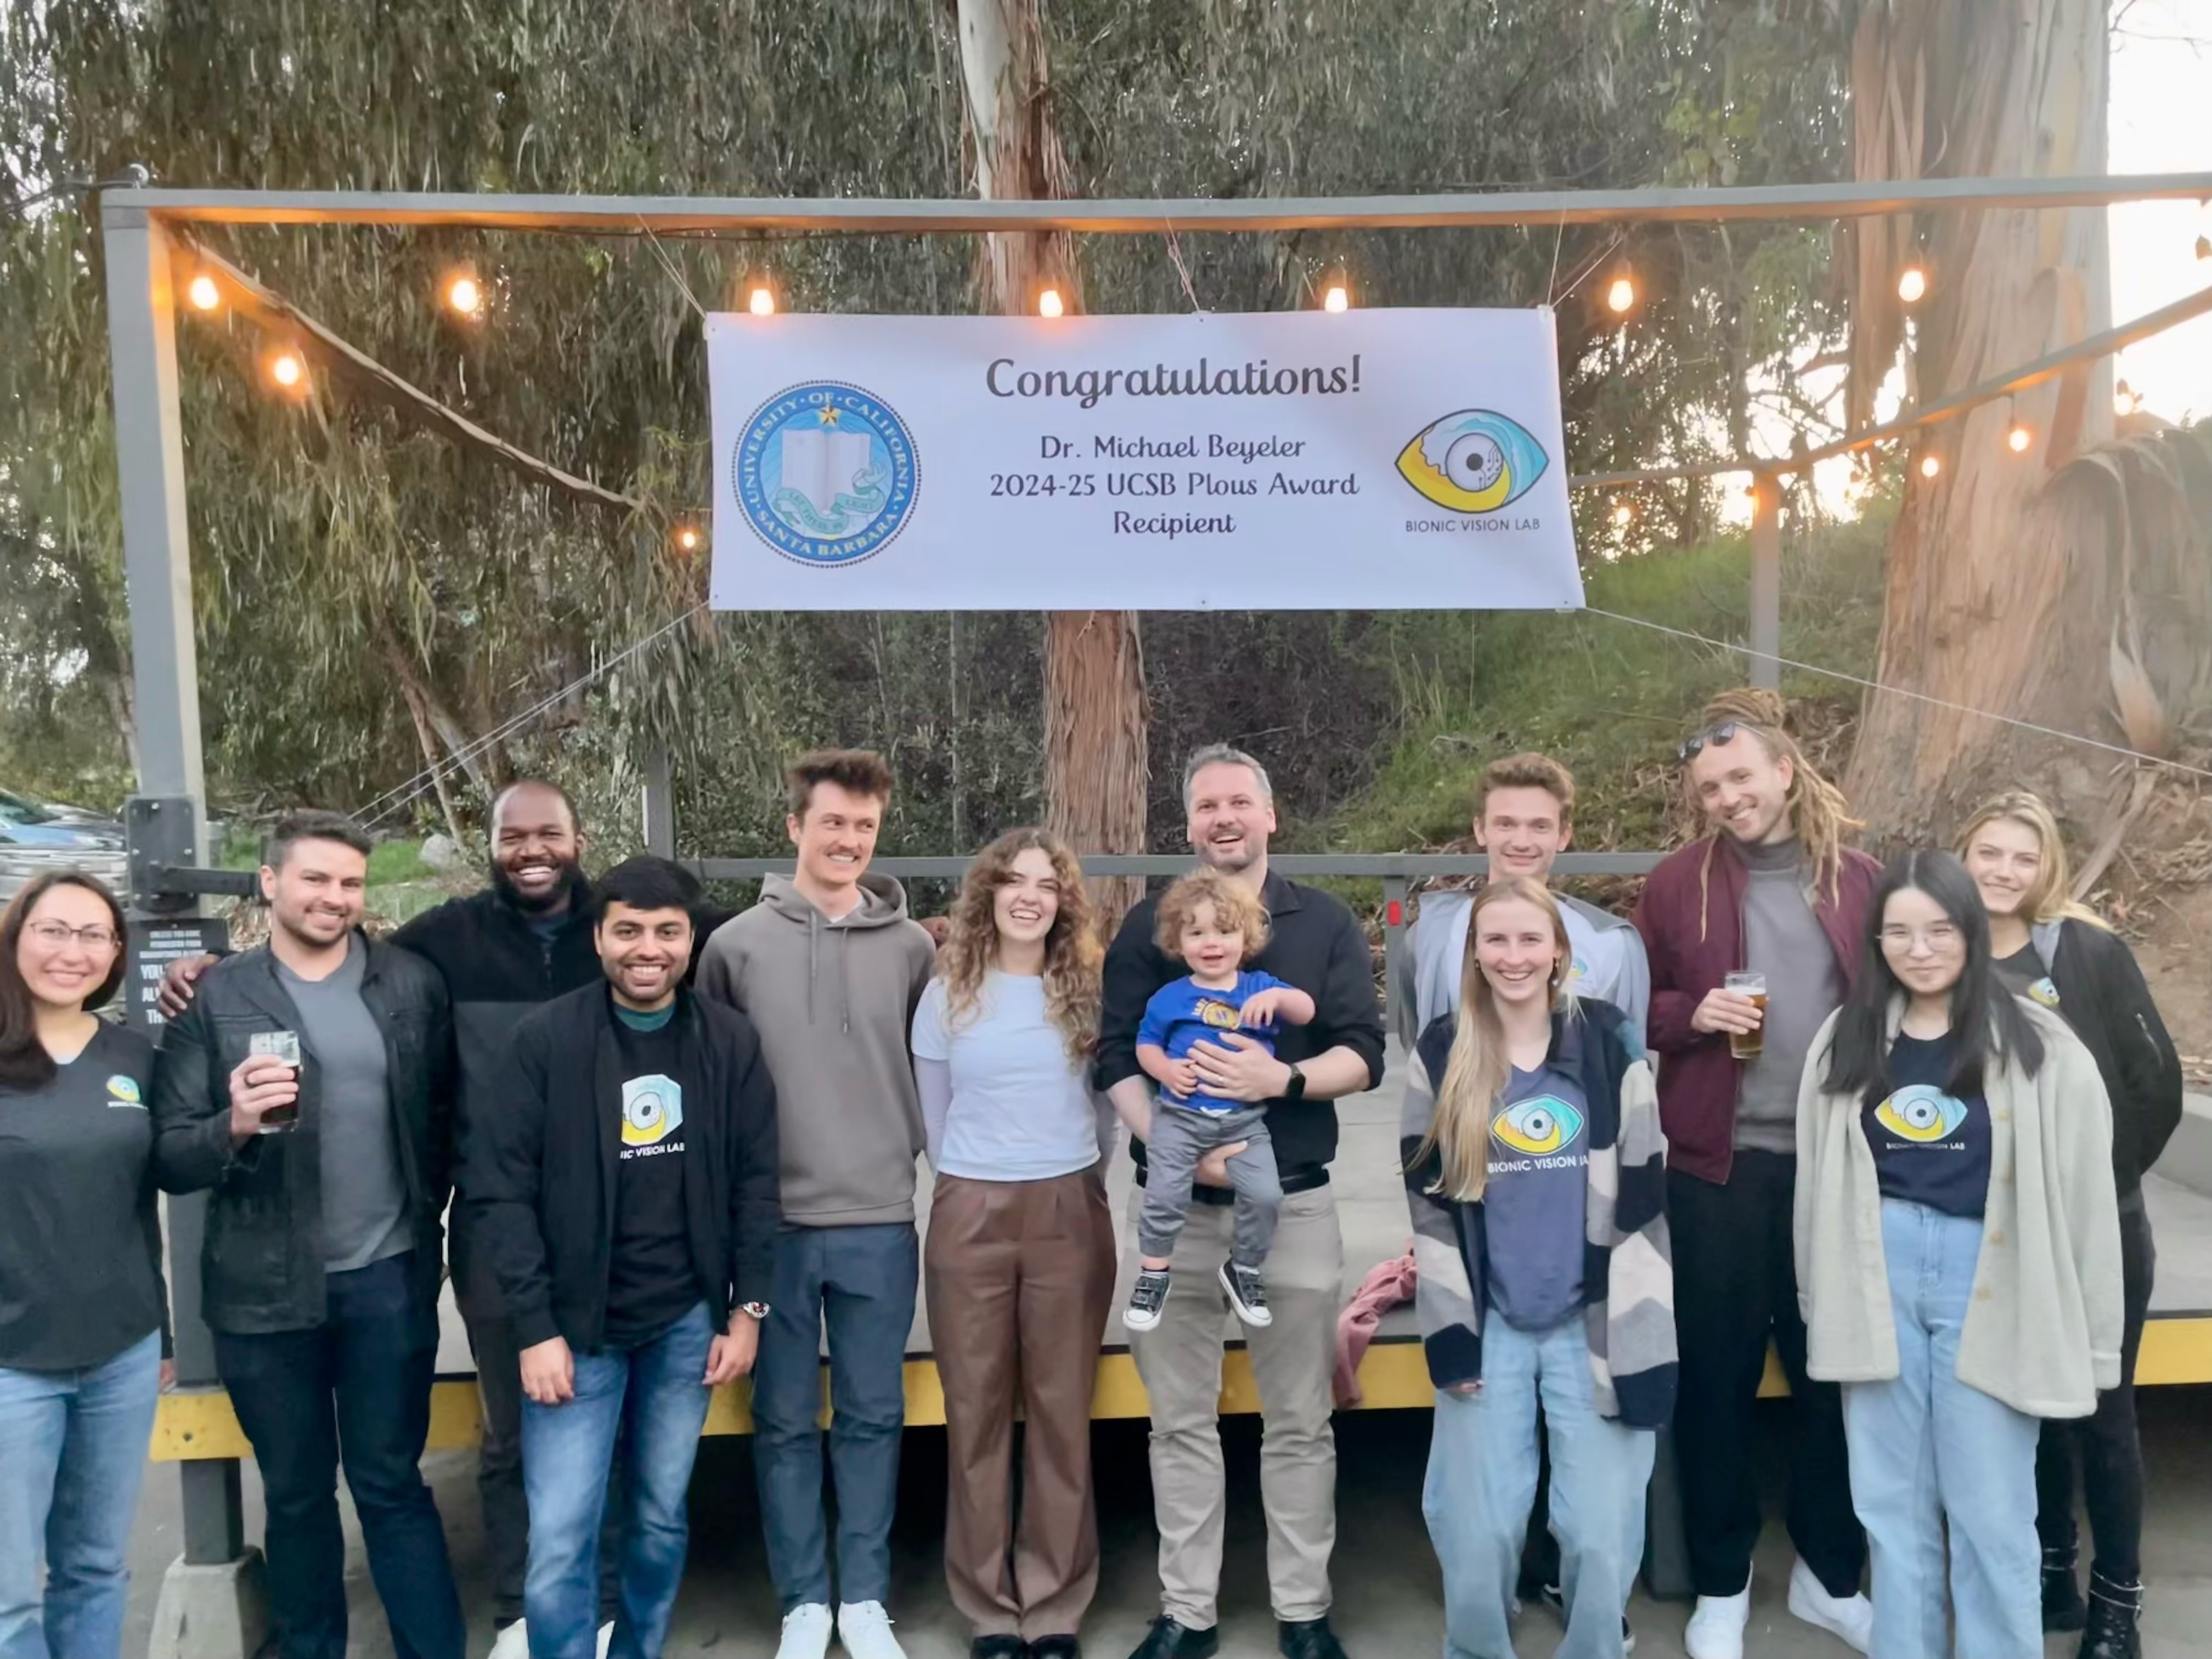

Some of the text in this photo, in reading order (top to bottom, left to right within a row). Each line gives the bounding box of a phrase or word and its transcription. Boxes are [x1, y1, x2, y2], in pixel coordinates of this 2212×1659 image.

[987, 354, 1361, 409] Congratulations!
[744, 392, 909, 503] UNIVERSITY OF CALIFORNIA
[1041, 434, 1306, 465] Dr. Michael Beyeler
[990, 472, 1361, 496] 2024-25 UCSB Plous Award
[758, 510, 897, 555] SANTA BARBARA
[1113, 511, 1237, 539] Recipient
[1405, 518, 1541, 533] BIONIC VISION LAB
[636, 1145, 665, 1157] VISION
[1487, 1160, 1531, 1174] BIONIC
[1534, 1156, 1577, 1170] VISION
